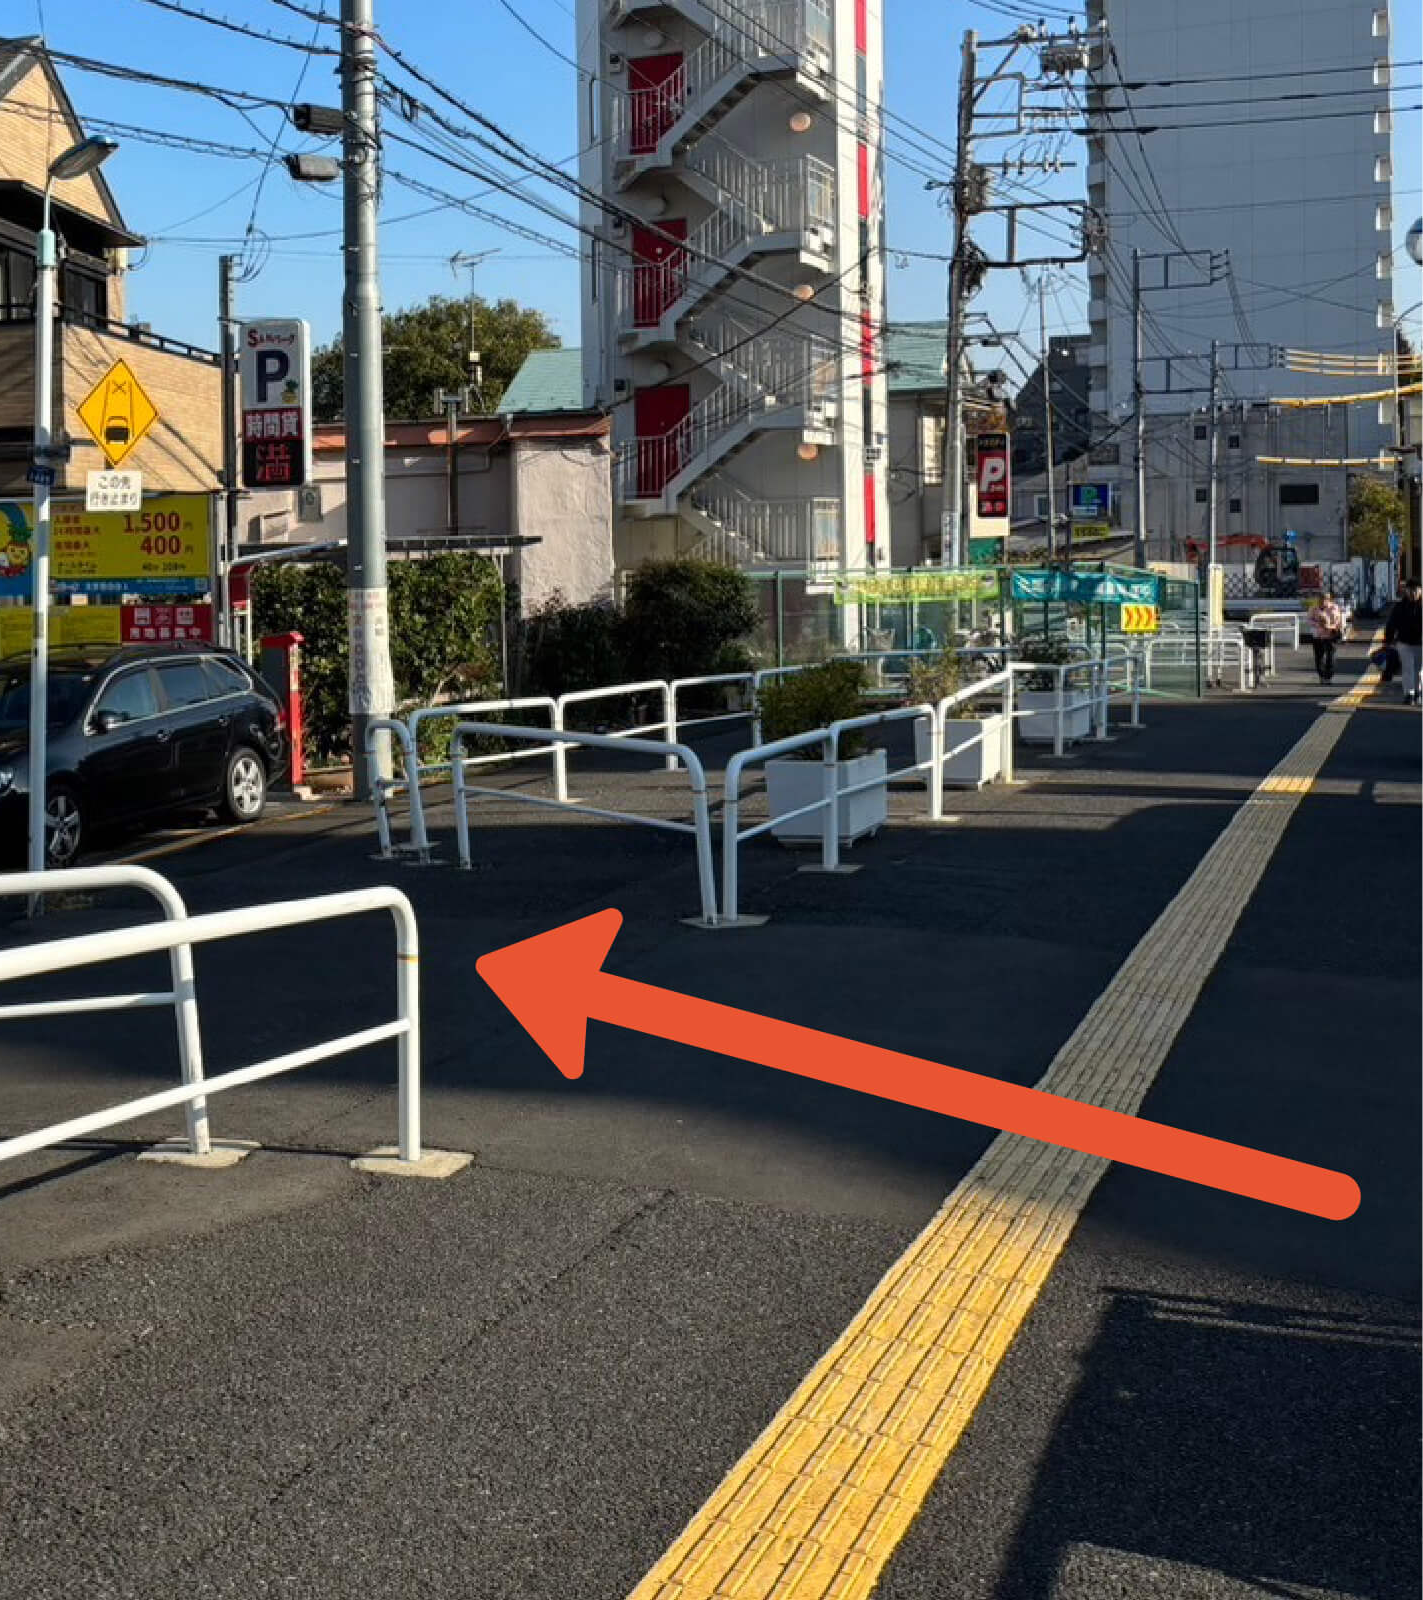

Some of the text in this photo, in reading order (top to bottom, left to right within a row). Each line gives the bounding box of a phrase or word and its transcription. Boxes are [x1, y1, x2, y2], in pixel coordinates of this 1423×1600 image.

[256, 350, 289, 403] P
[246, 411, 299, 439] 時間貸
[256, 444, 290, 482] 満
[980, 457, 1005, 493] P
[98, 475, 131, 490] この先
